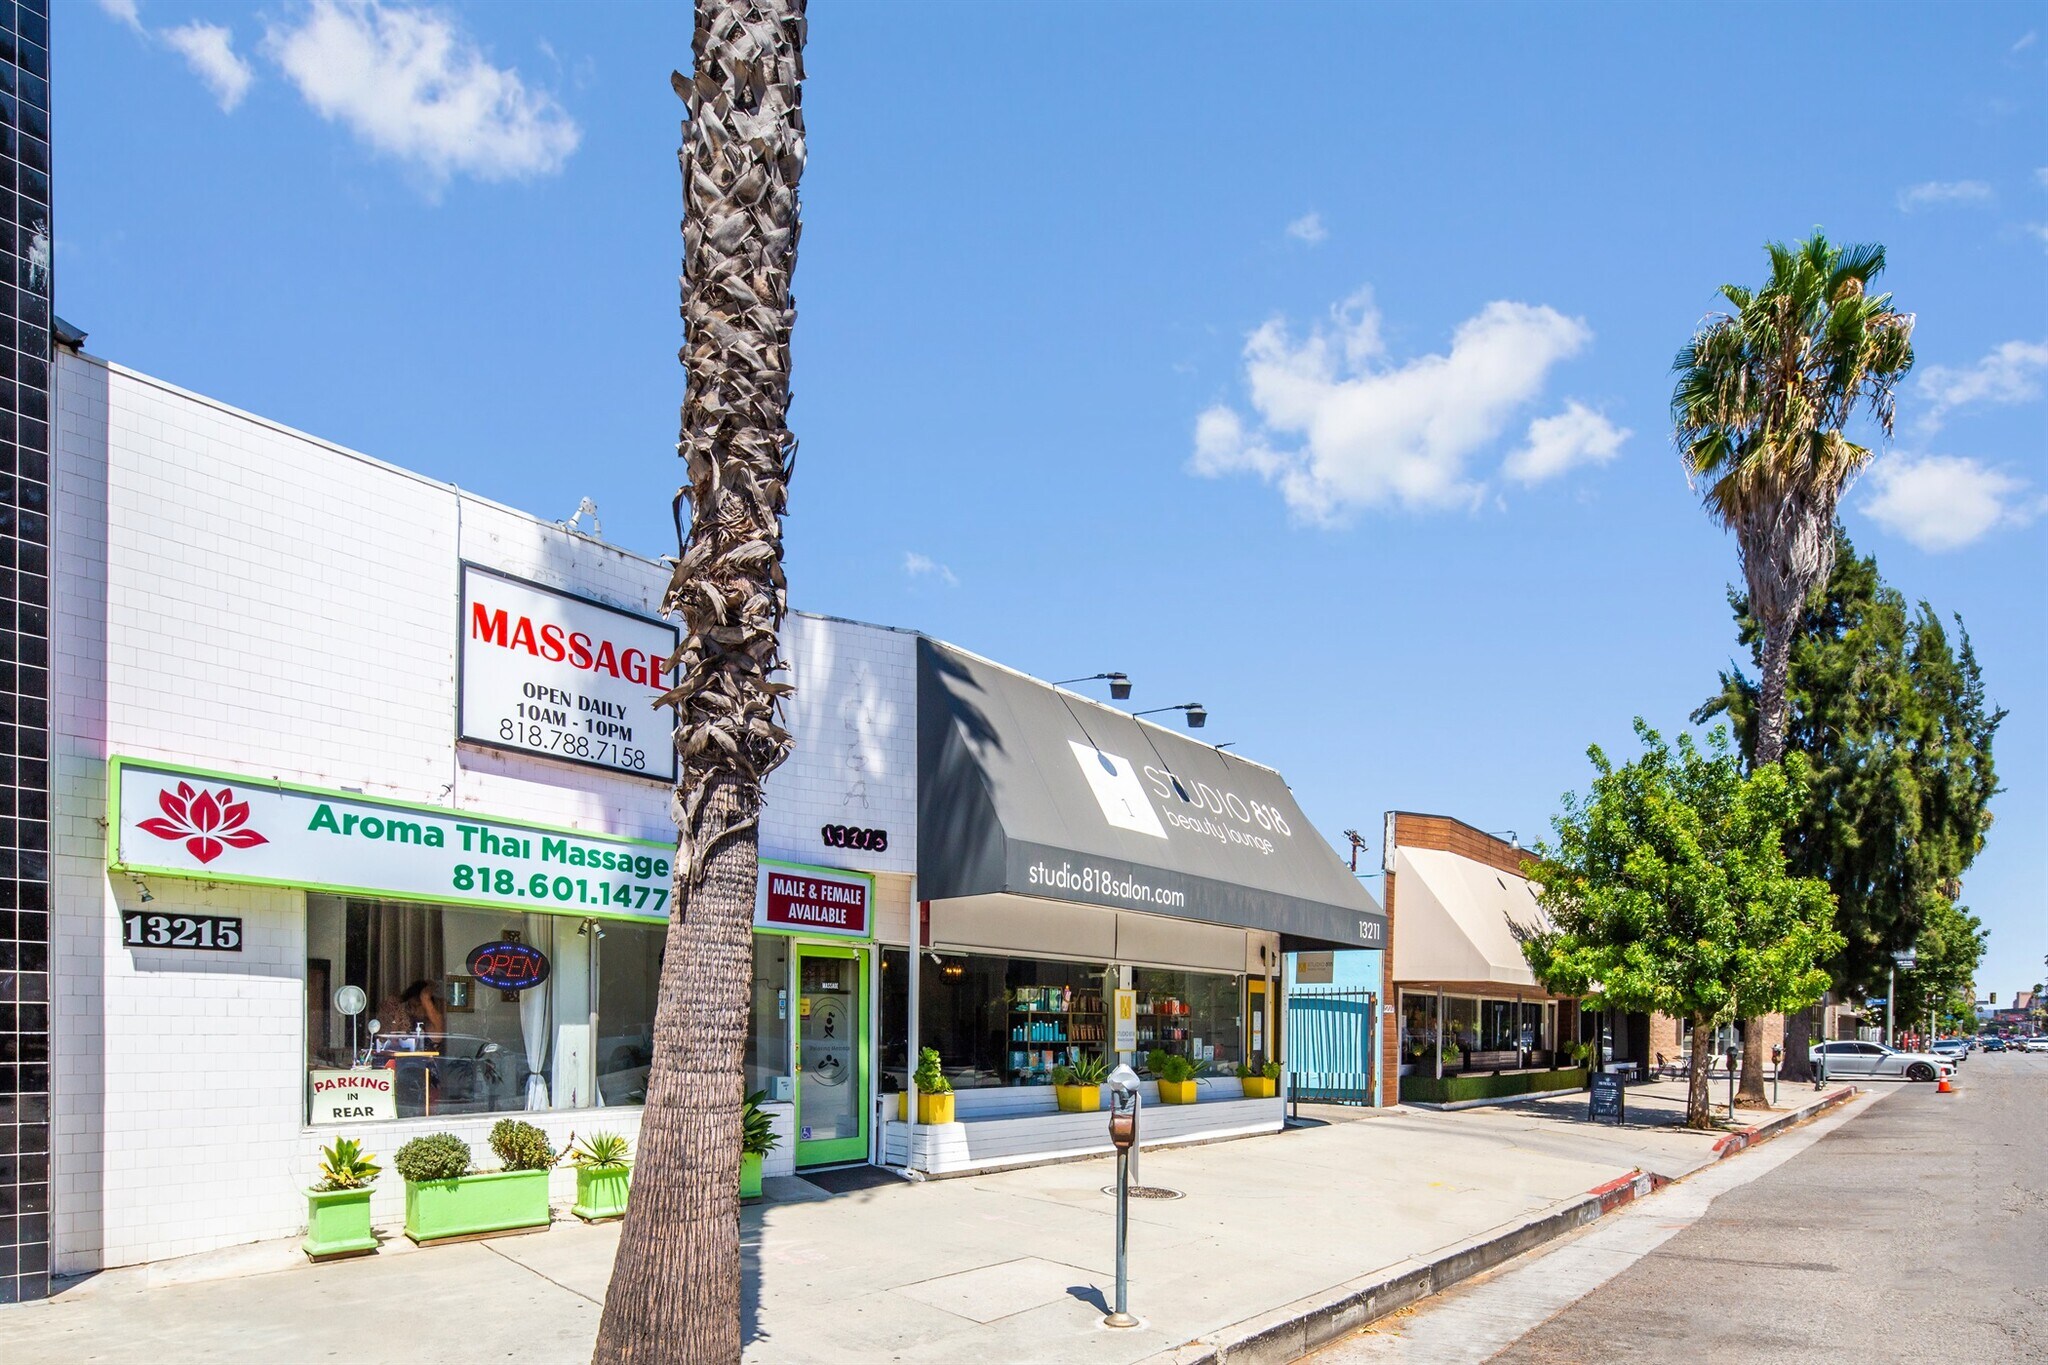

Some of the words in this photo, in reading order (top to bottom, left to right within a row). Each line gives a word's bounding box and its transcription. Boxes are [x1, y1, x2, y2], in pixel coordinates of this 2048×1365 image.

[472, 602, 672, 692] MASSAGE
[523, 682, 572, 708] OPEN
[578, 694, 627, 720] DAILY
[516, 703, 567, 728] 10AM
[585, 718, 633, 742] 10PM
[499, 718, 646, 770] 818.788.7158
[1143, 765, 1251, 823] STUDIO
[1250, 799, 1292, 837] 818
[307, 803, 445, 849] Aroma
[456, 825, 532, 859] Thai
[542, 837, 669, 879] Massage
[1162, 804, 1227, 844] beauty
[1222, 822, 1275, 855] lounge
[452, 866, 669, 912] 818.601.1477
[773, 878, 805, 898] MALE
[808, 883, 818, 900] &
[821, 884, 861, 905] FEMALE
[1028, 861, 1185, 908] studio818salon.com
[788, 902, 847, 924] AVAILABLE
[1358, 920, 1380, 940] 13211
[125, 916, 241, 949] 13215
[474, 954, 543, 978] OPEN
[314, 1076, 390, 1093] PARKING
[347, 1093, 359, 1101] IN
[333, 1106, 374, 1118] REAR
